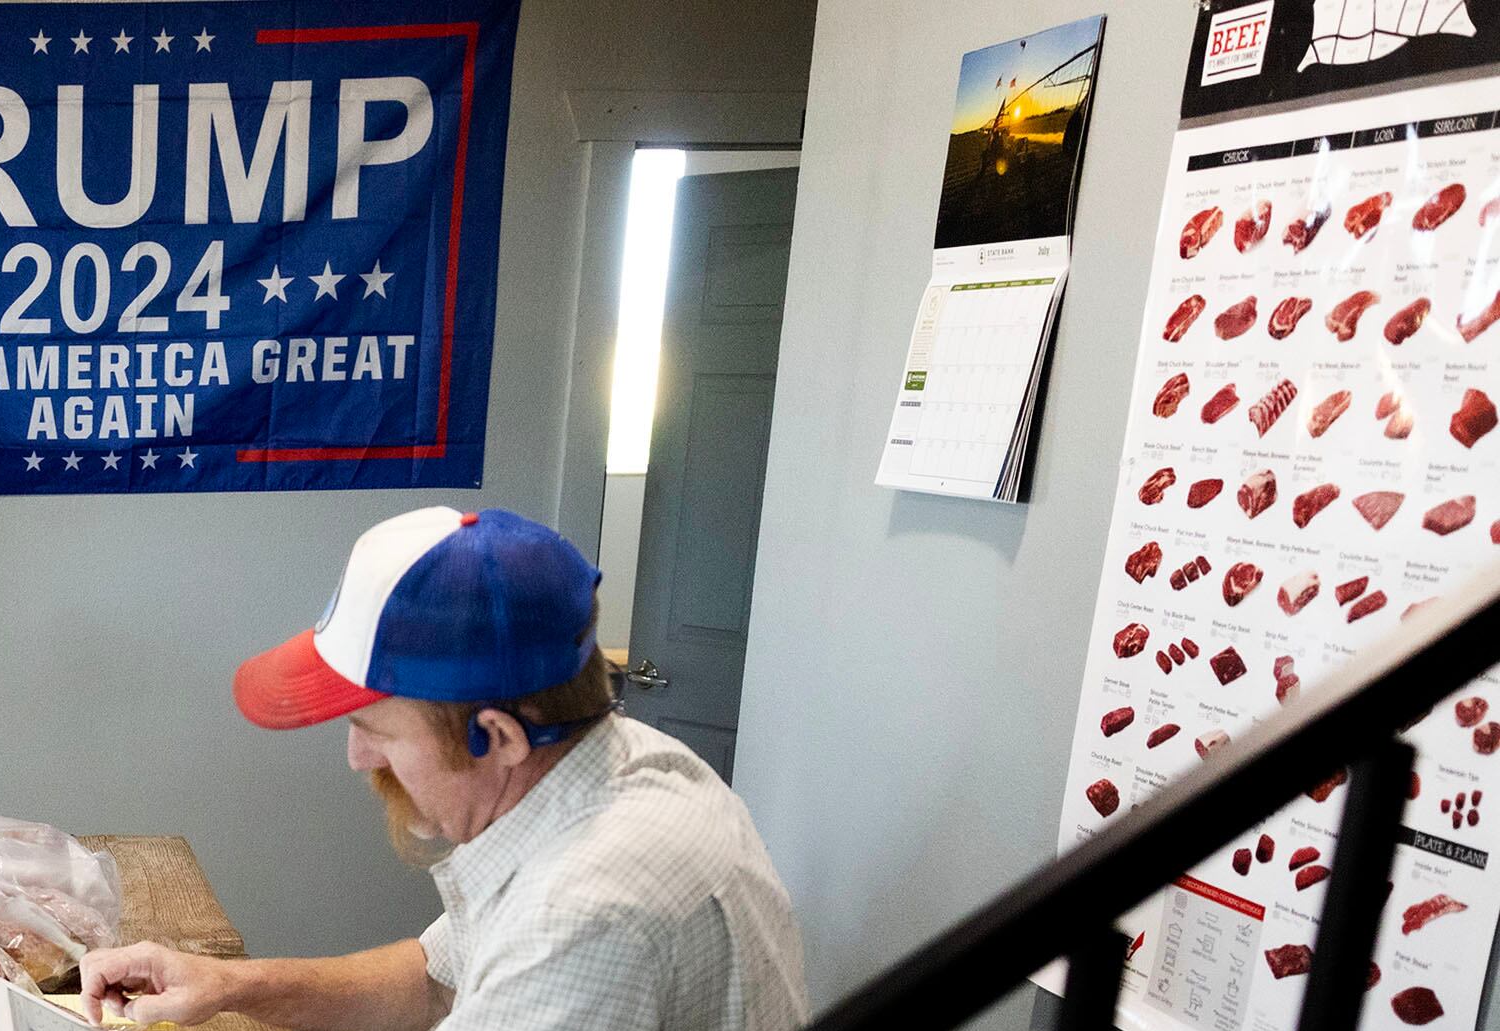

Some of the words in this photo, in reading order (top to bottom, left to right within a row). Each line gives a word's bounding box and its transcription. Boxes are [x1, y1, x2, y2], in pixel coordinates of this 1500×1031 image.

[1374, 128, 1395, 142] LOIN
[1433, 117, 1477, 135] SIRLOIN
[1222, 150, 1250, 164] CHUCK
[0, 239, 230, 334] 2024
[251, 335, 415, 384] GREAT
[27, 392, 195, 441] AGAIN
[1415, 831, 1445, 854] PLATE
[1446, 843, 1453, 856] &
[1454, 844, 1488, 868] FLANK
